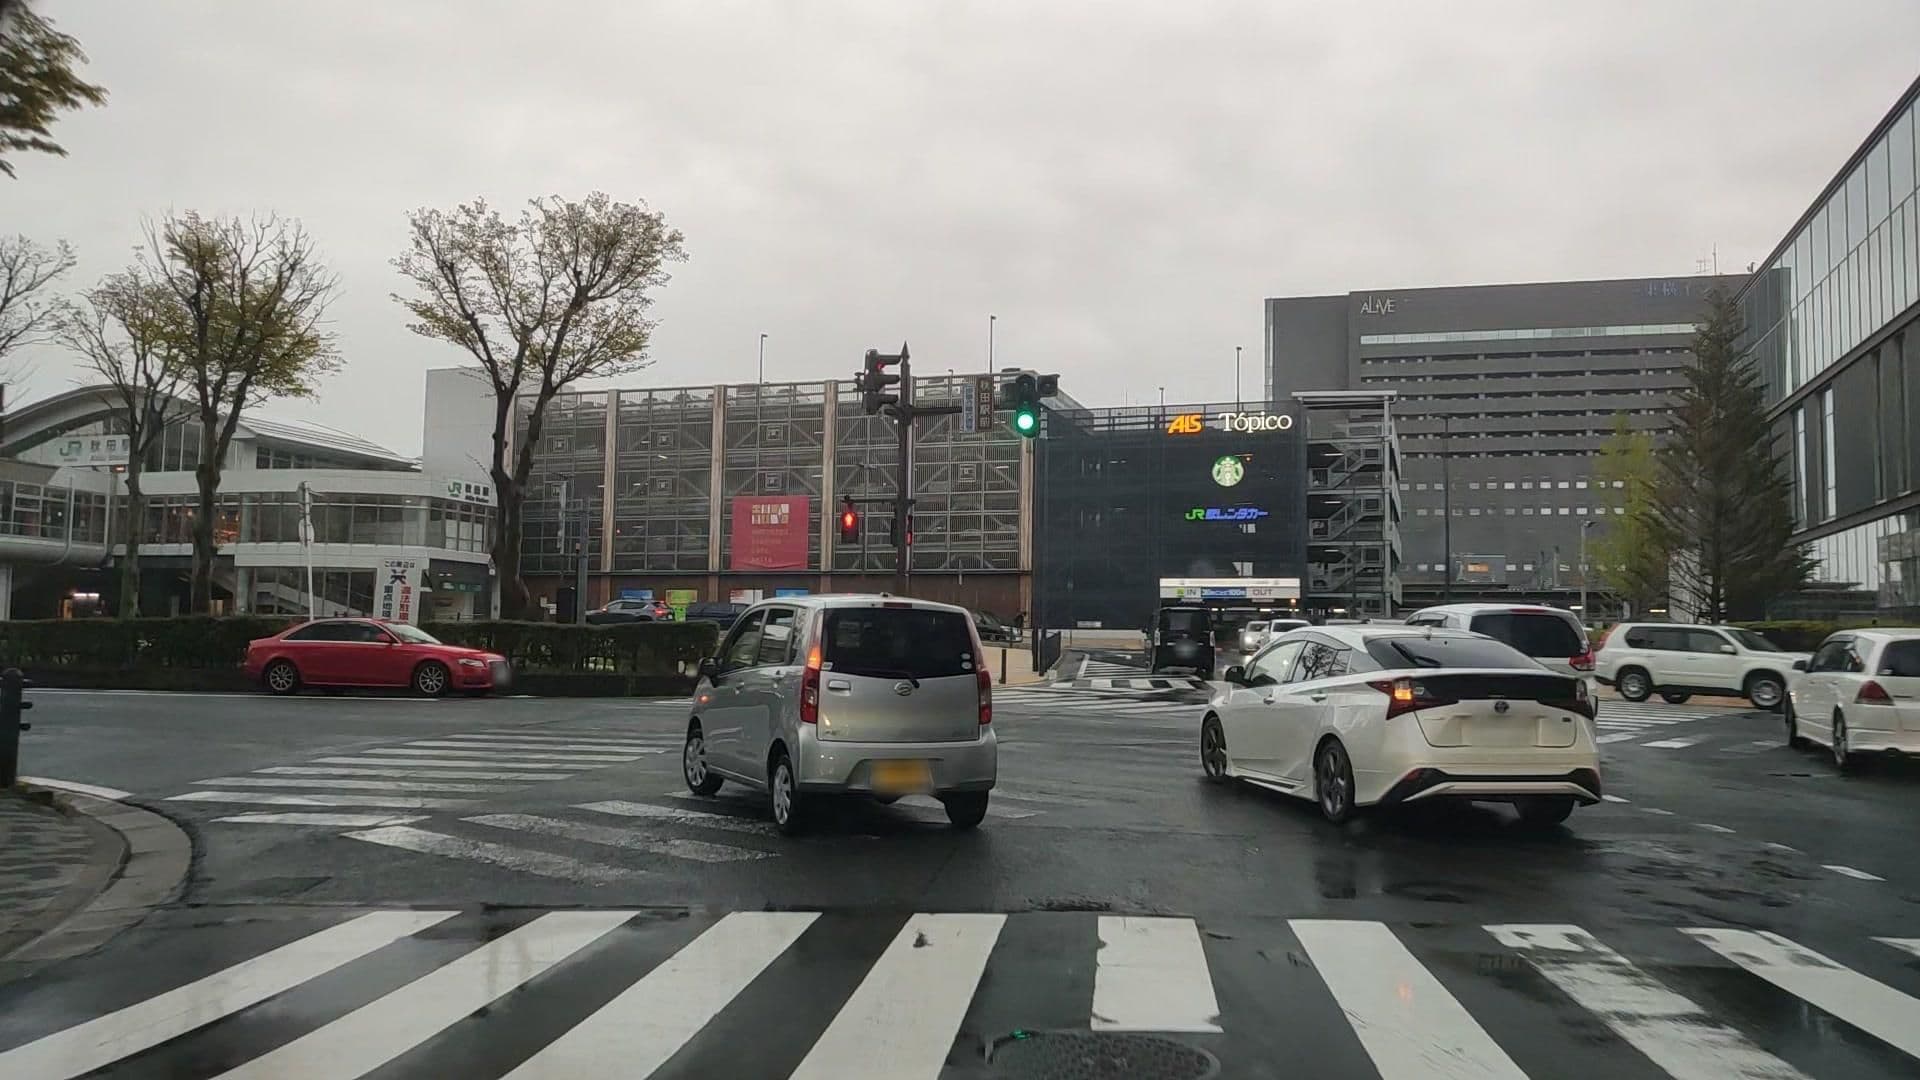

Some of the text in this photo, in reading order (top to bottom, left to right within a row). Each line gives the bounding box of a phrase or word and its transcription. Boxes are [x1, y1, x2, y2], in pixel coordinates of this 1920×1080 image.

[980, 379, 991, 427] 秋田駅前
[1218, 411, 1293, 434] Tópico
[447, 481, 462, 494] JR
[1186, 588, 1197, 596] IN
[1252, 588, 1273, 596] OUT
